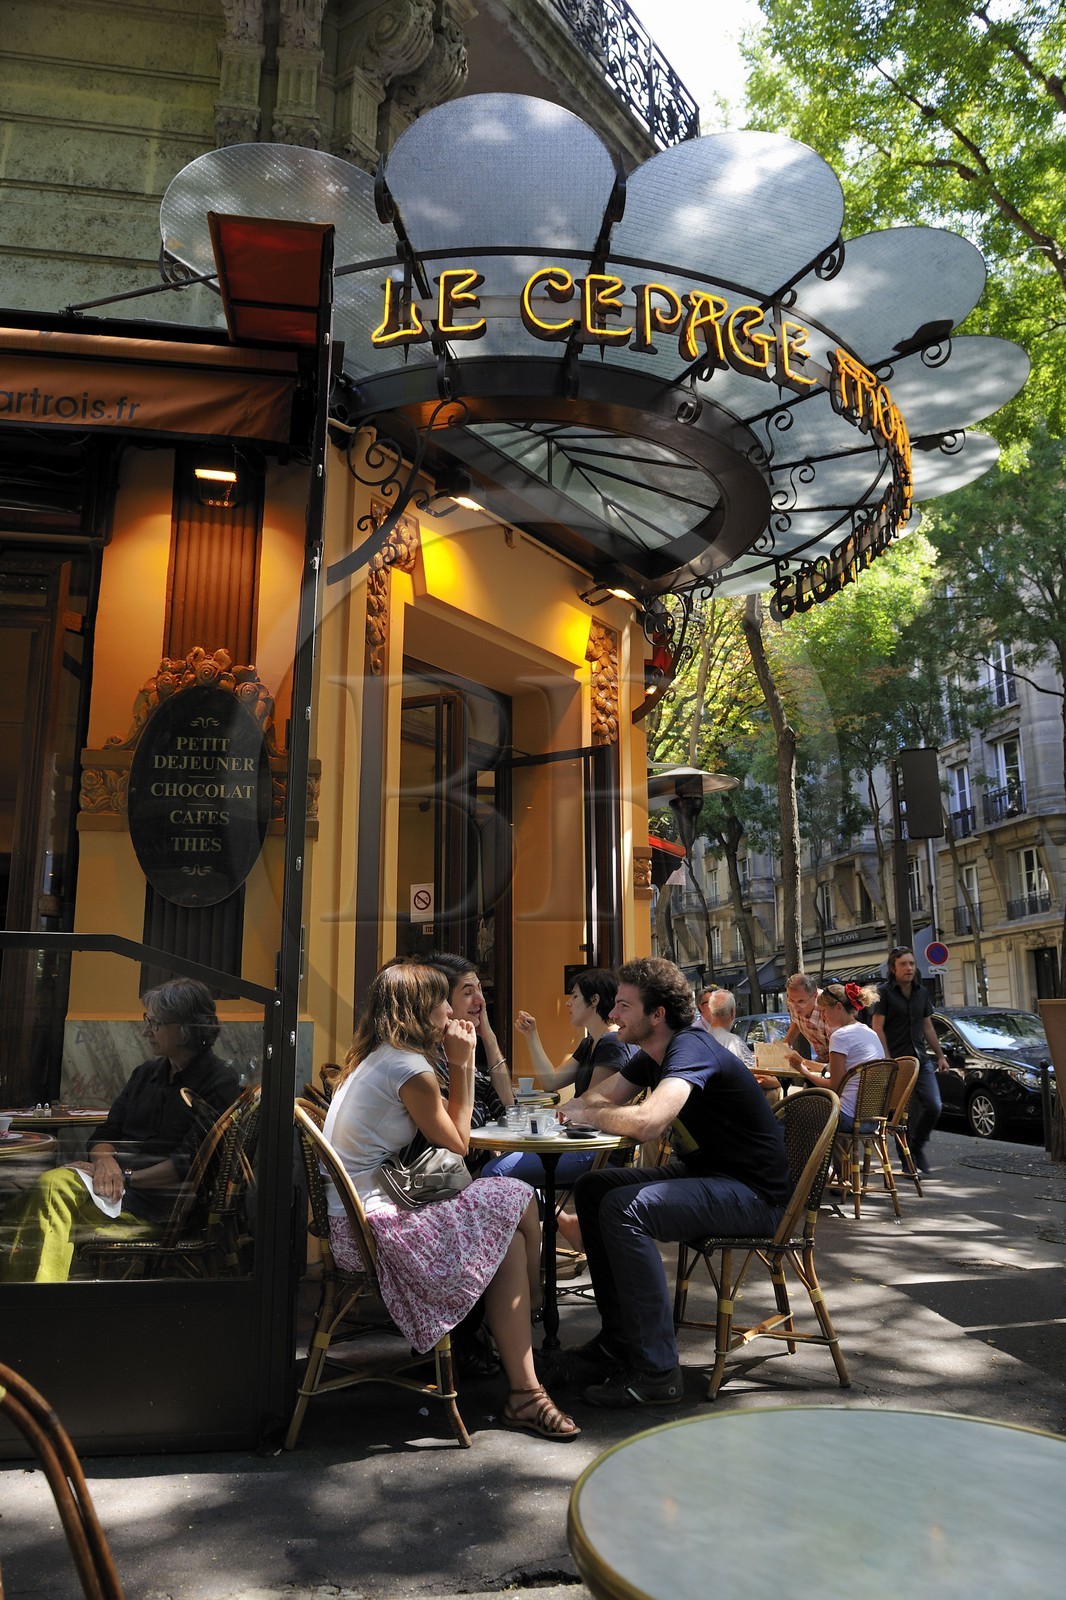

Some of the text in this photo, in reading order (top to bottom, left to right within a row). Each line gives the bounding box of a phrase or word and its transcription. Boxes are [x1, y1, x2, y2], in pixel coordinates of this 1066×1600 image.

[371, 268, 487, 349] LE
[520, 266, 817, 396] CEPAGE
[176, 736, 231, 752] PETIT
[153, 755, 255, 772] DEJEUNER
[150, 782, 255, 799] CHOCOLAT
[169, 809, 230, 826] CAFES
[171, 836, 222, 852] THES
